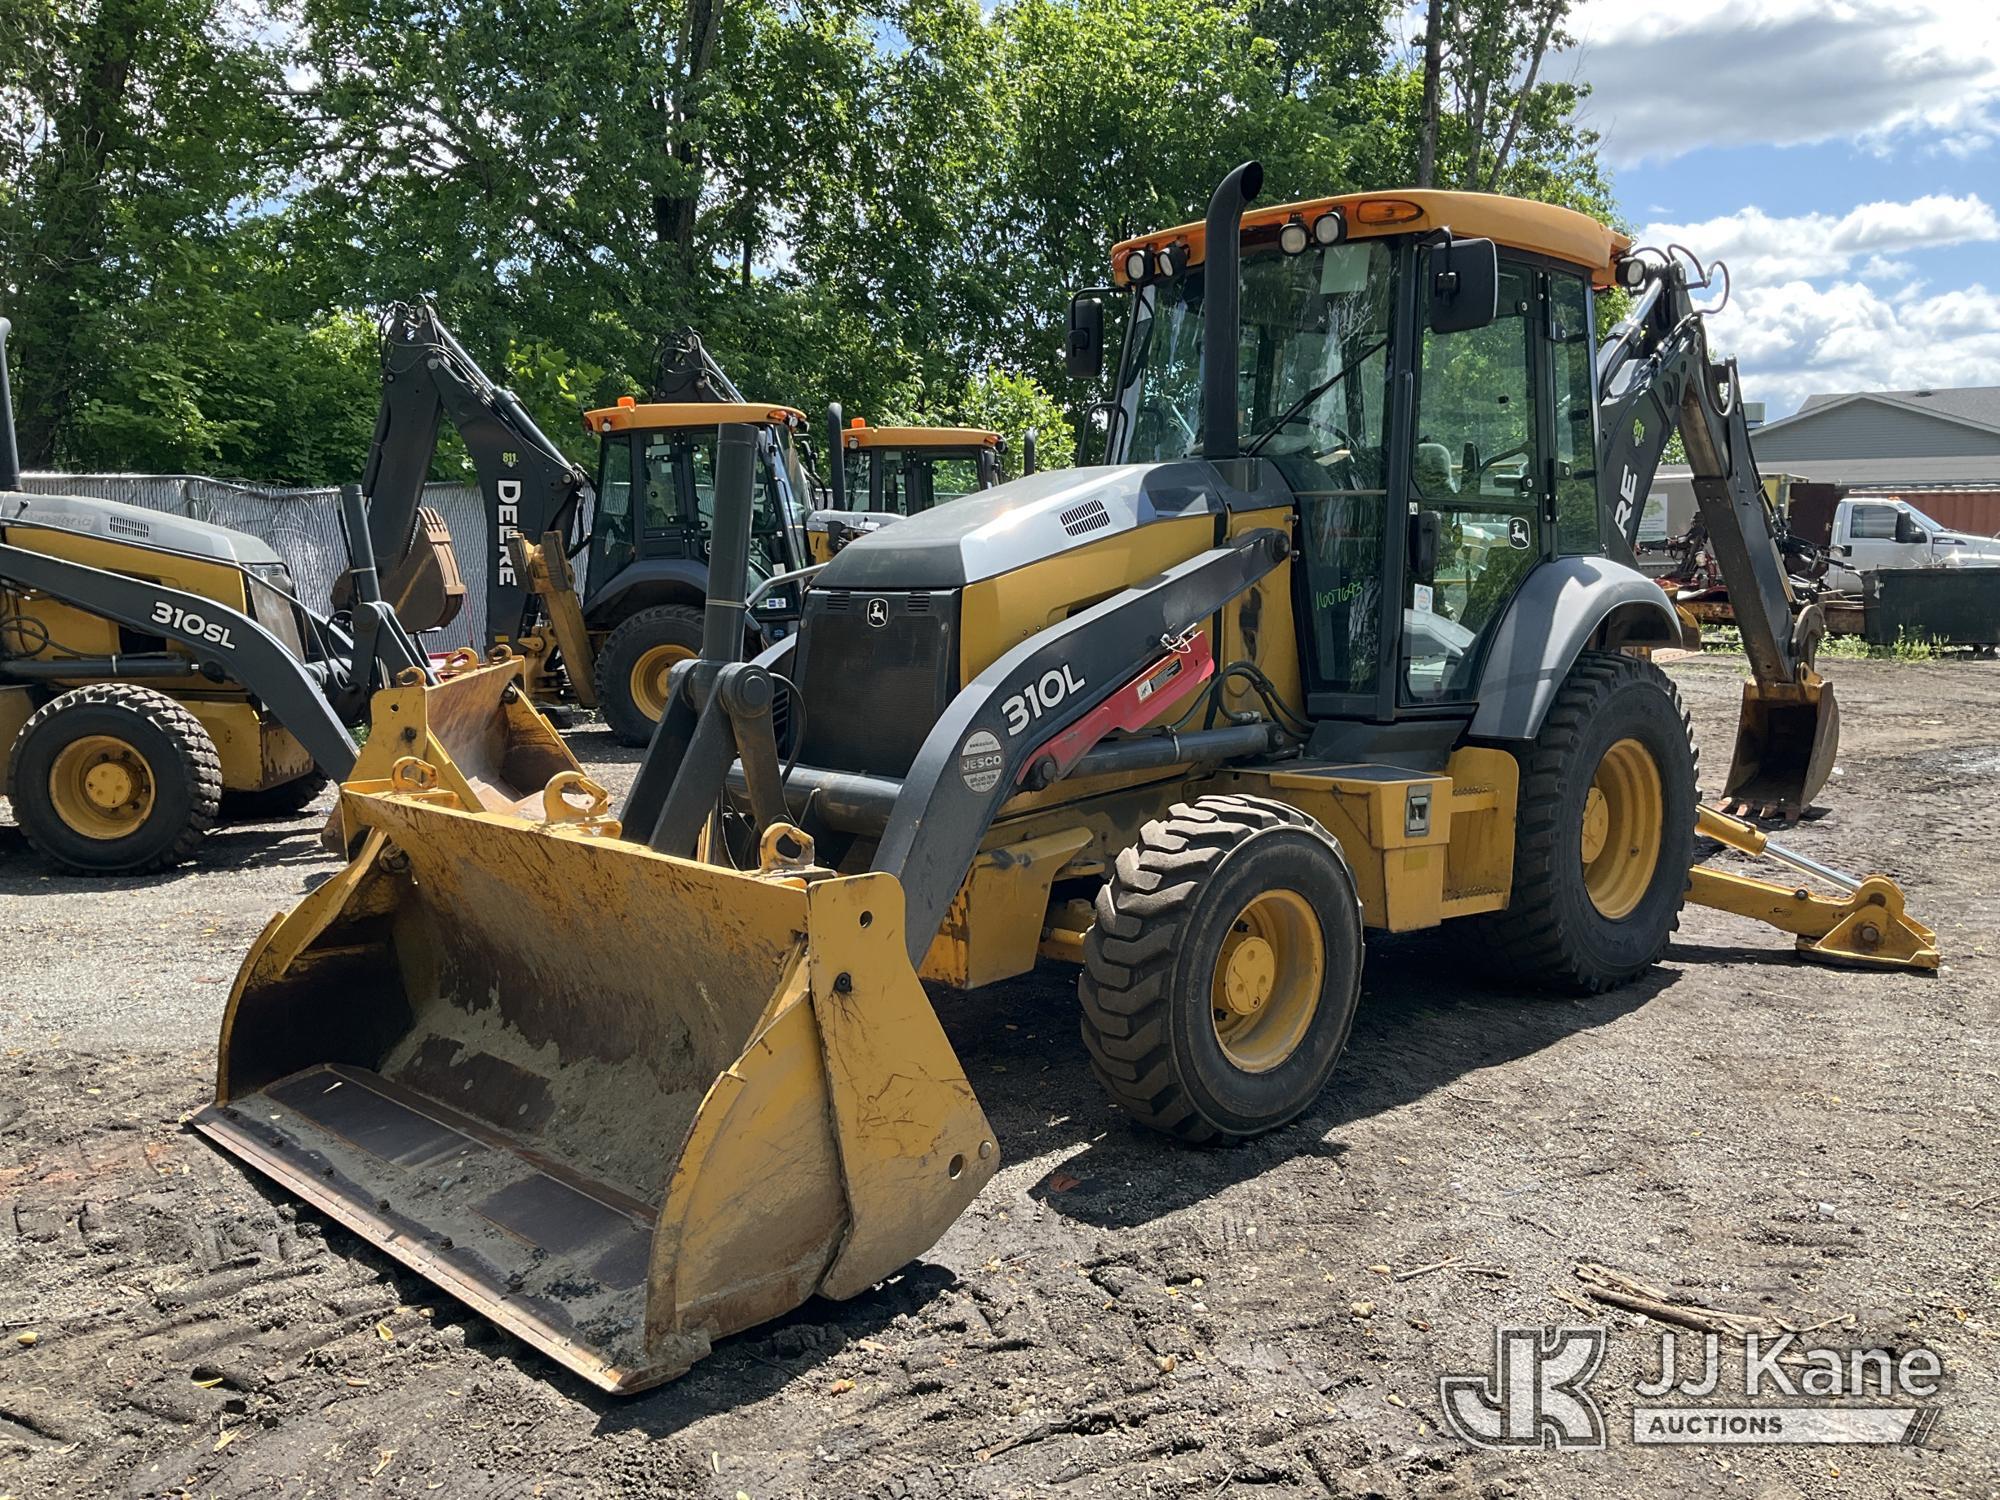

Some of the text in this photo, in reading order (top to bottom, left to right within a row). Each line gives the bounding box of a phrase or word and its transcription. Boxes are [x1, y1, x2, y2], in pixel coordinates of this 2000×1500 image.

[151, 601, 235, 649] 310SL
[1002, 664, 1085, 736] 310L
[963, 755, 1002, 771] JESCO
